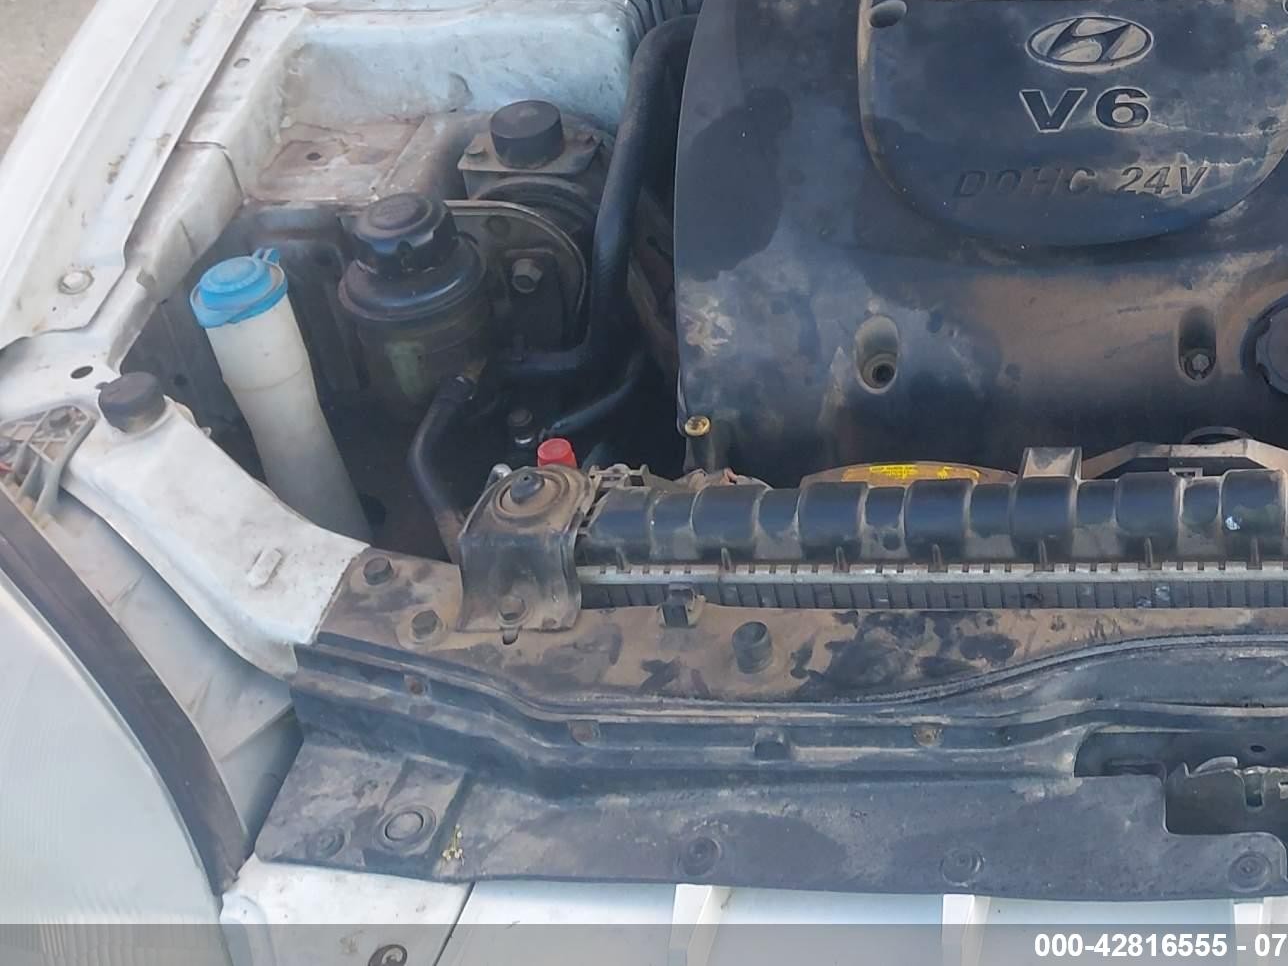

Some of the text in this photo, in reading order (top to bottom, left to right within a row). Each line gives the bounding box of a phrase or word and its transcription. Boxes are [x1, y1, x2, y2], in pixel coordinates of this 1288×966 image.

[1019, 86, 1152, 134] V6
[953, 165, 1209, 198] DOHC 24V
